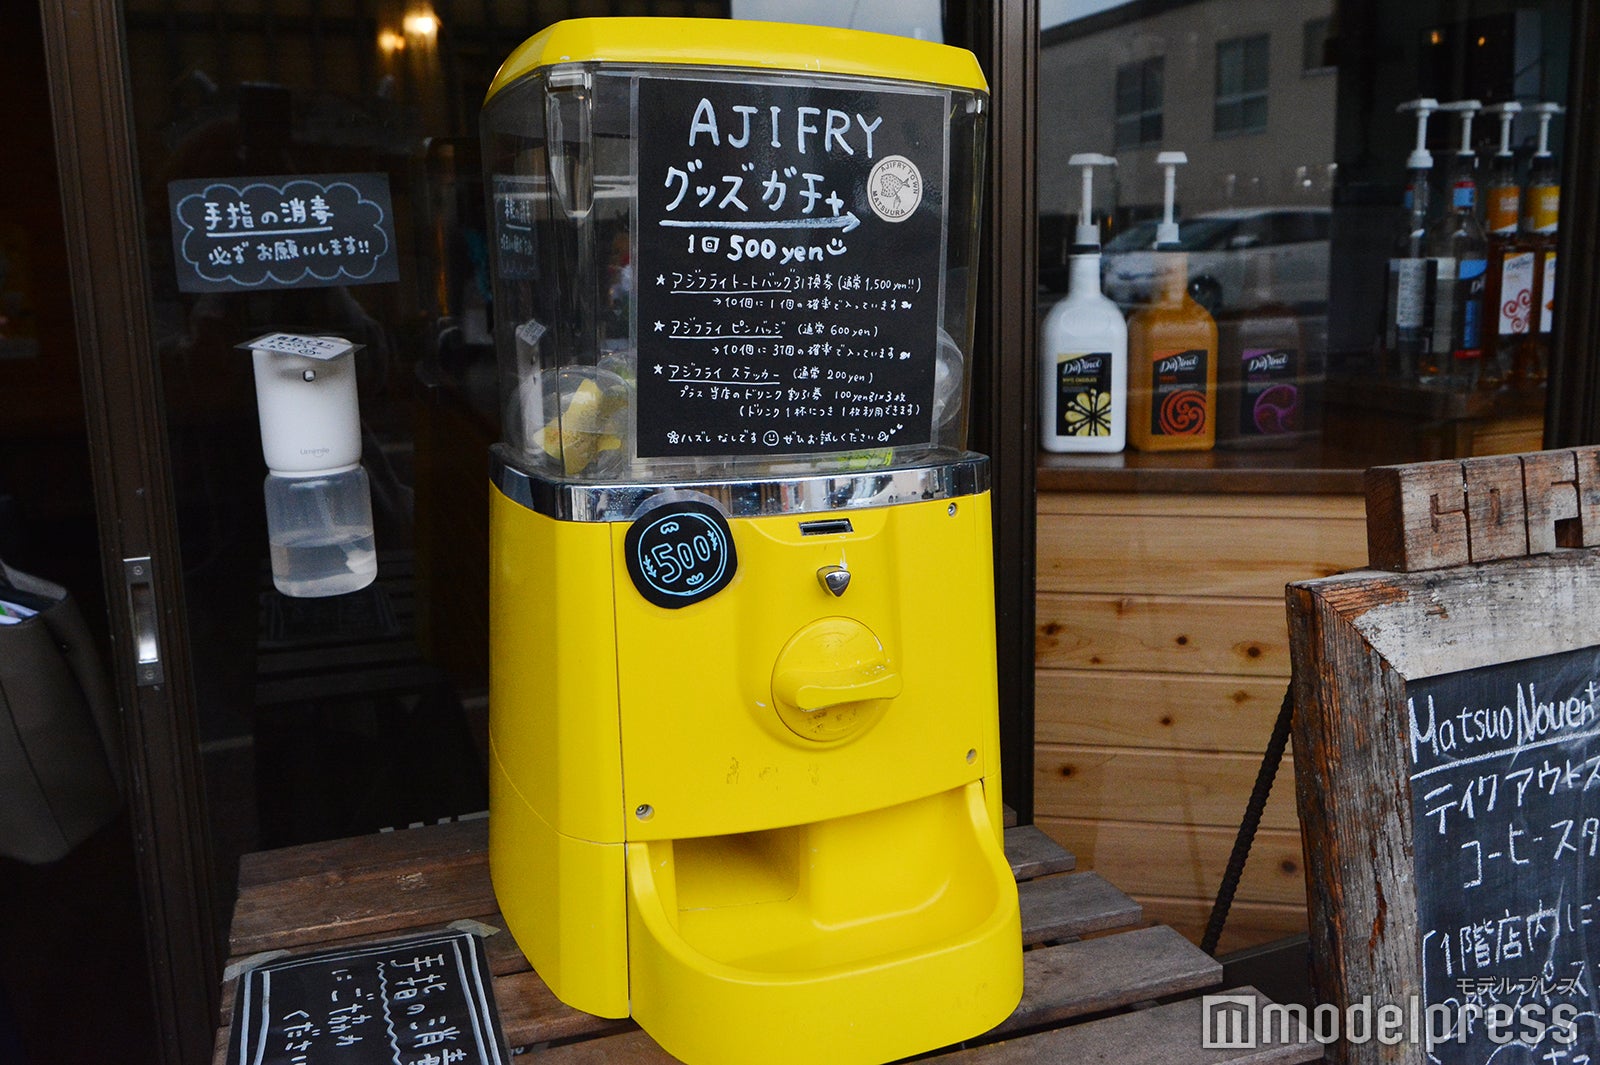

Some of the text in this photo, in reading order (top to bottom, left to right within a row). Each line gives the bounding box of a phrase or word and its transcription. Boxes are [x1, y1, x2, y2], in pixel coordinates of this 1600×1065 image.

[689, 98, 882, 158] AJIFRY
[881, 161, 919, 195] AJIFRY TOWN
[204, 195, 334, 230] 手指の消毒
[873, 190, 906, 216] MATSUURA
[651, 535, 711, 584] 500
